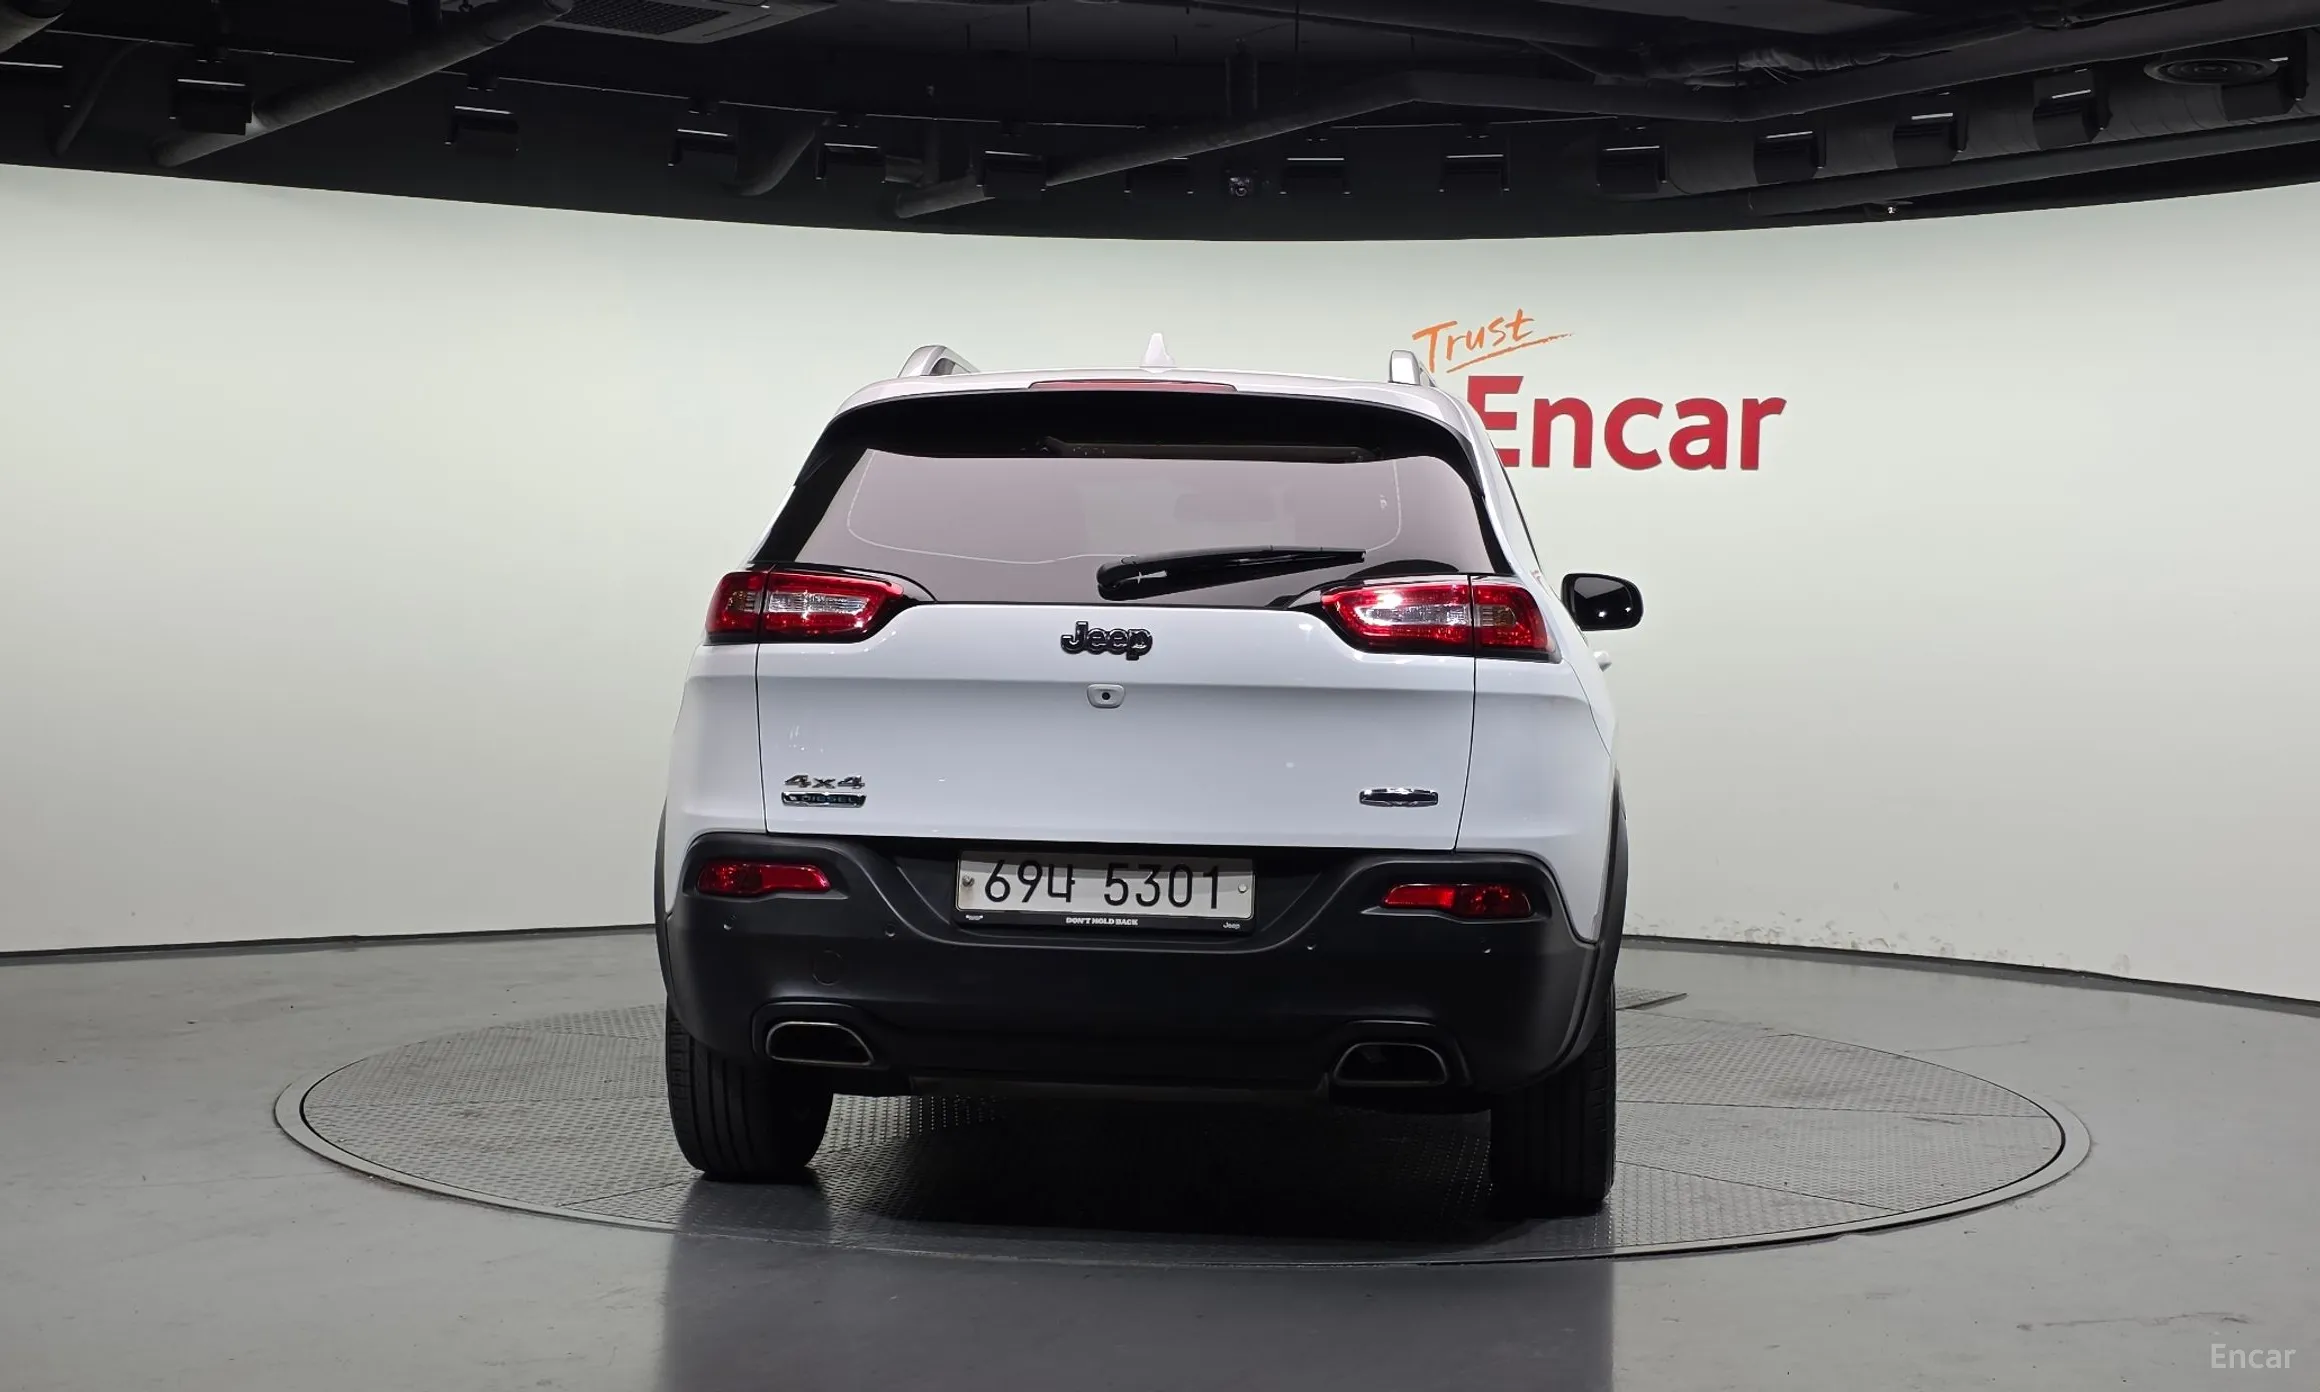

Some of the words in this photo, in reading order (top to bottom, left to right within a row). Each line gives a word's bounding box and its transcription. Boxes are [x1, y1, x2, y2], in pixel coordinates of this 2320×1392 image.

[1412, 308, 1534, 373] Trust
[1466, 375, 1788, 471] Encar
[1060, 620, 1153, 661] Jeep
[784, 774, 866, 790] 4x4
[984, 859, 1076, 903] 69나
[1103, 862, 1220, 910] 5301
[1065, 916, 1091, 925] DON'T
[1091, 917, 1115, 925] HOLD
[1115, 918, 1139, 926] BACK
[1222, 921, 1241, 930] Jeep
